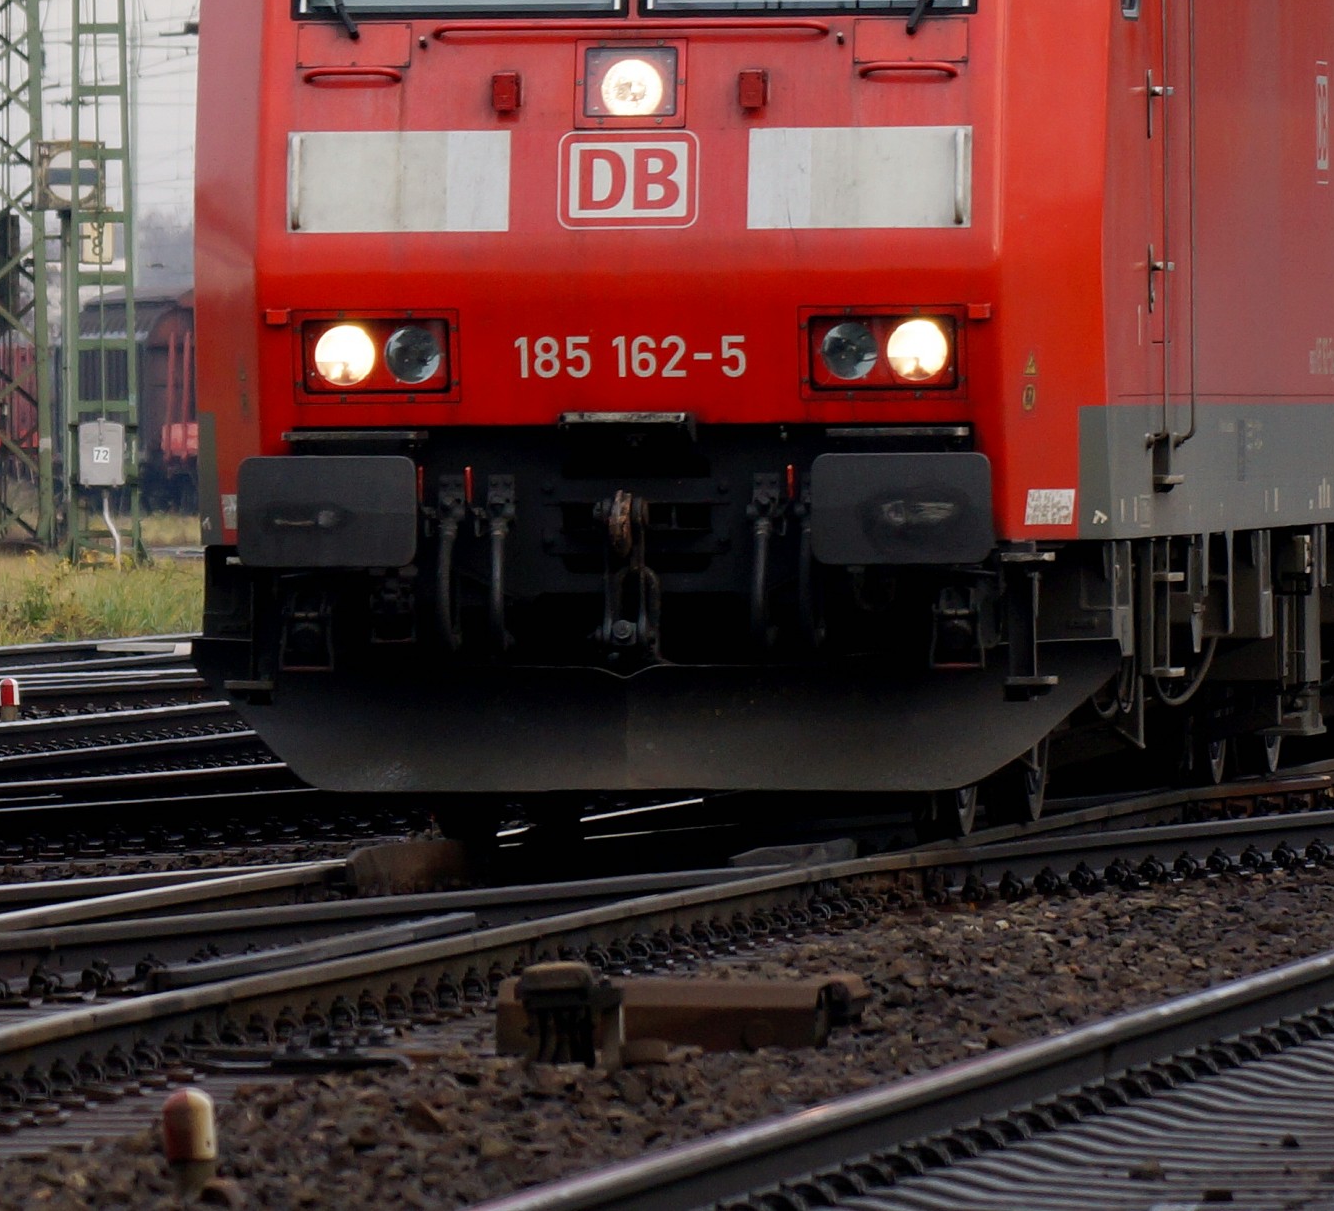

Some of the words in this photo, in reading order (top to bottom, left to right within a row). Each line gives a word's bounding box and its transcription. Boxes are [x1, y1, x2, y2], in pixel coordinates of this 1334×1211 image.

[578, 147, 680, 211] DB
[514, 336, 591, 378] 185
[611, 335, 746, 378] 162-5
[94, 449, 109, 461] 72
